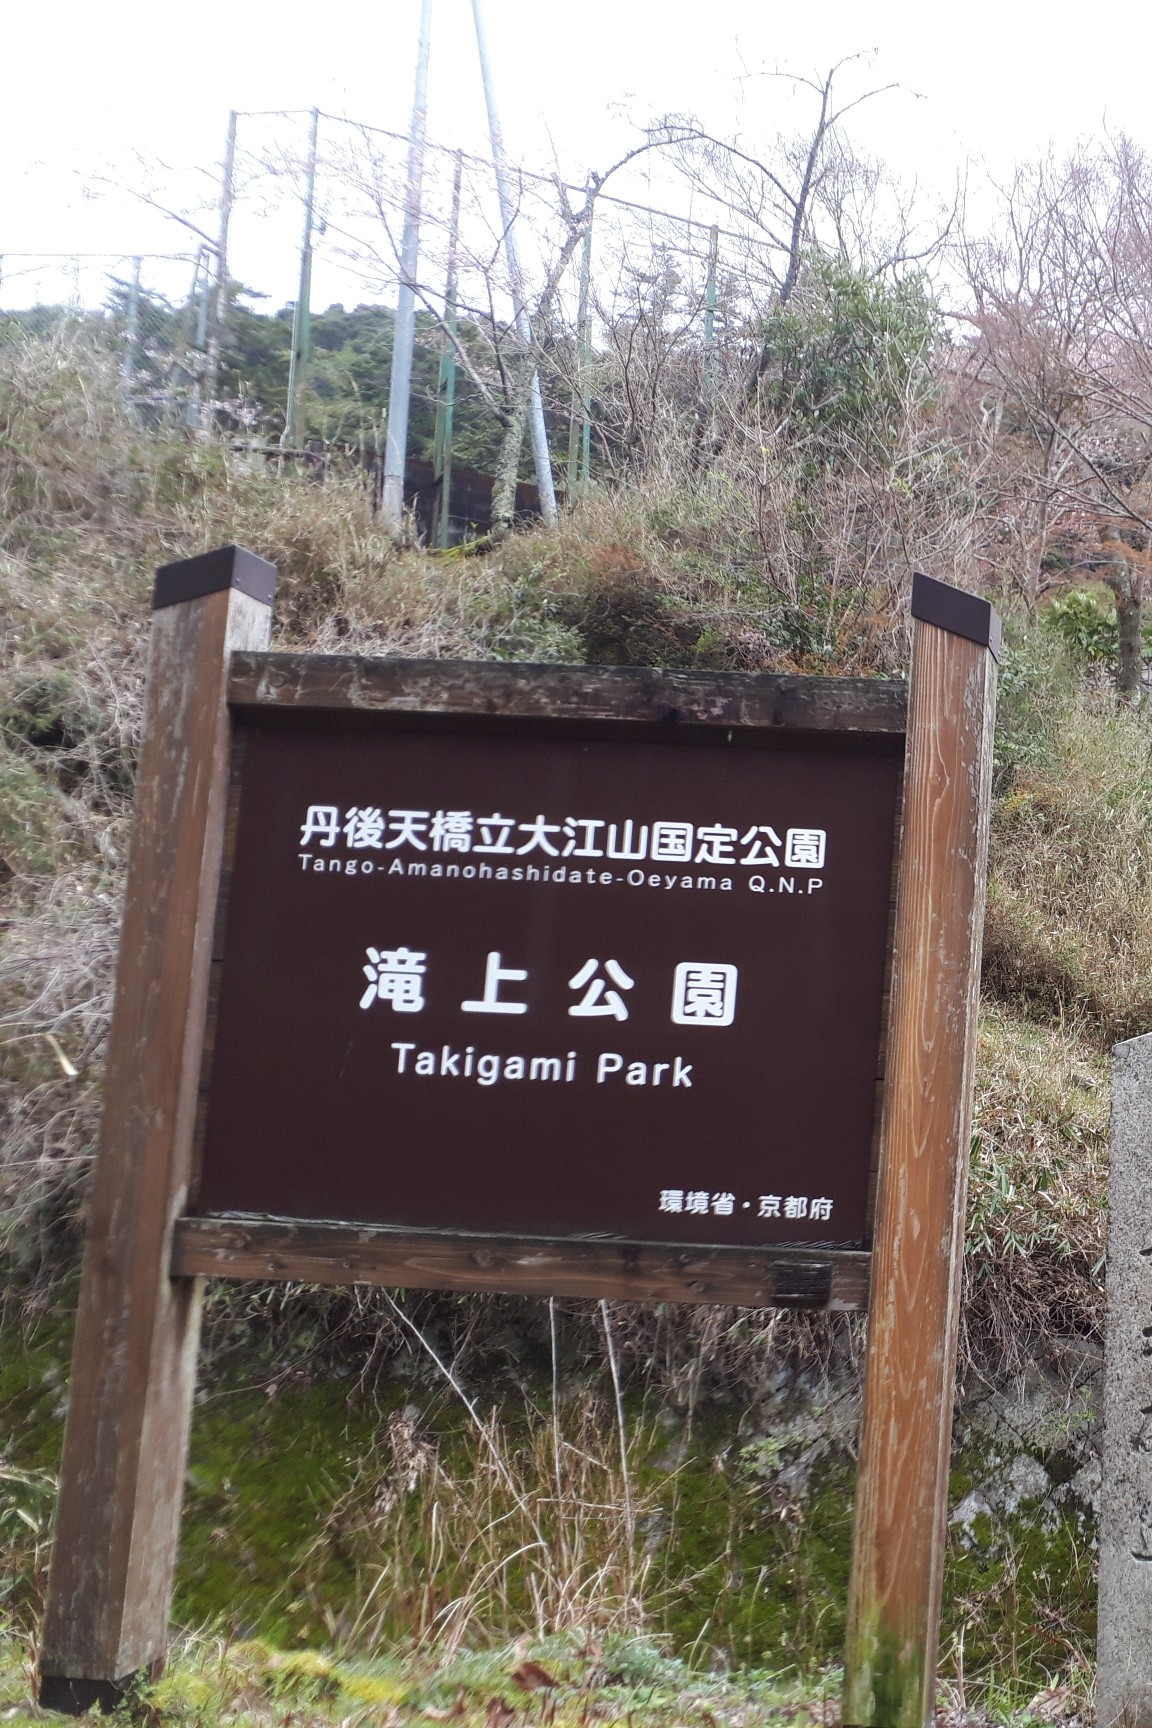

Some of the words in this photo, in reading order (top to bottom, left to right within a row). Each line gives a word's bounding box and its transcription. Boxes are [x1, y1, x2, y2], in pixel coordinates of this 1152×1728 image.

[299, 805, 827, 869] 丹後天橋立大江山国定公園
[297, 853, 733, 891] Tango-Amanohashidate-Oeyama
[748, 875, 824, 895] Q.N.P
[358, 946, 738, 1027] 滝上公園
[390, 1042, 577, 1086] Takigami
[596, 1052, 694, 1088] Park
